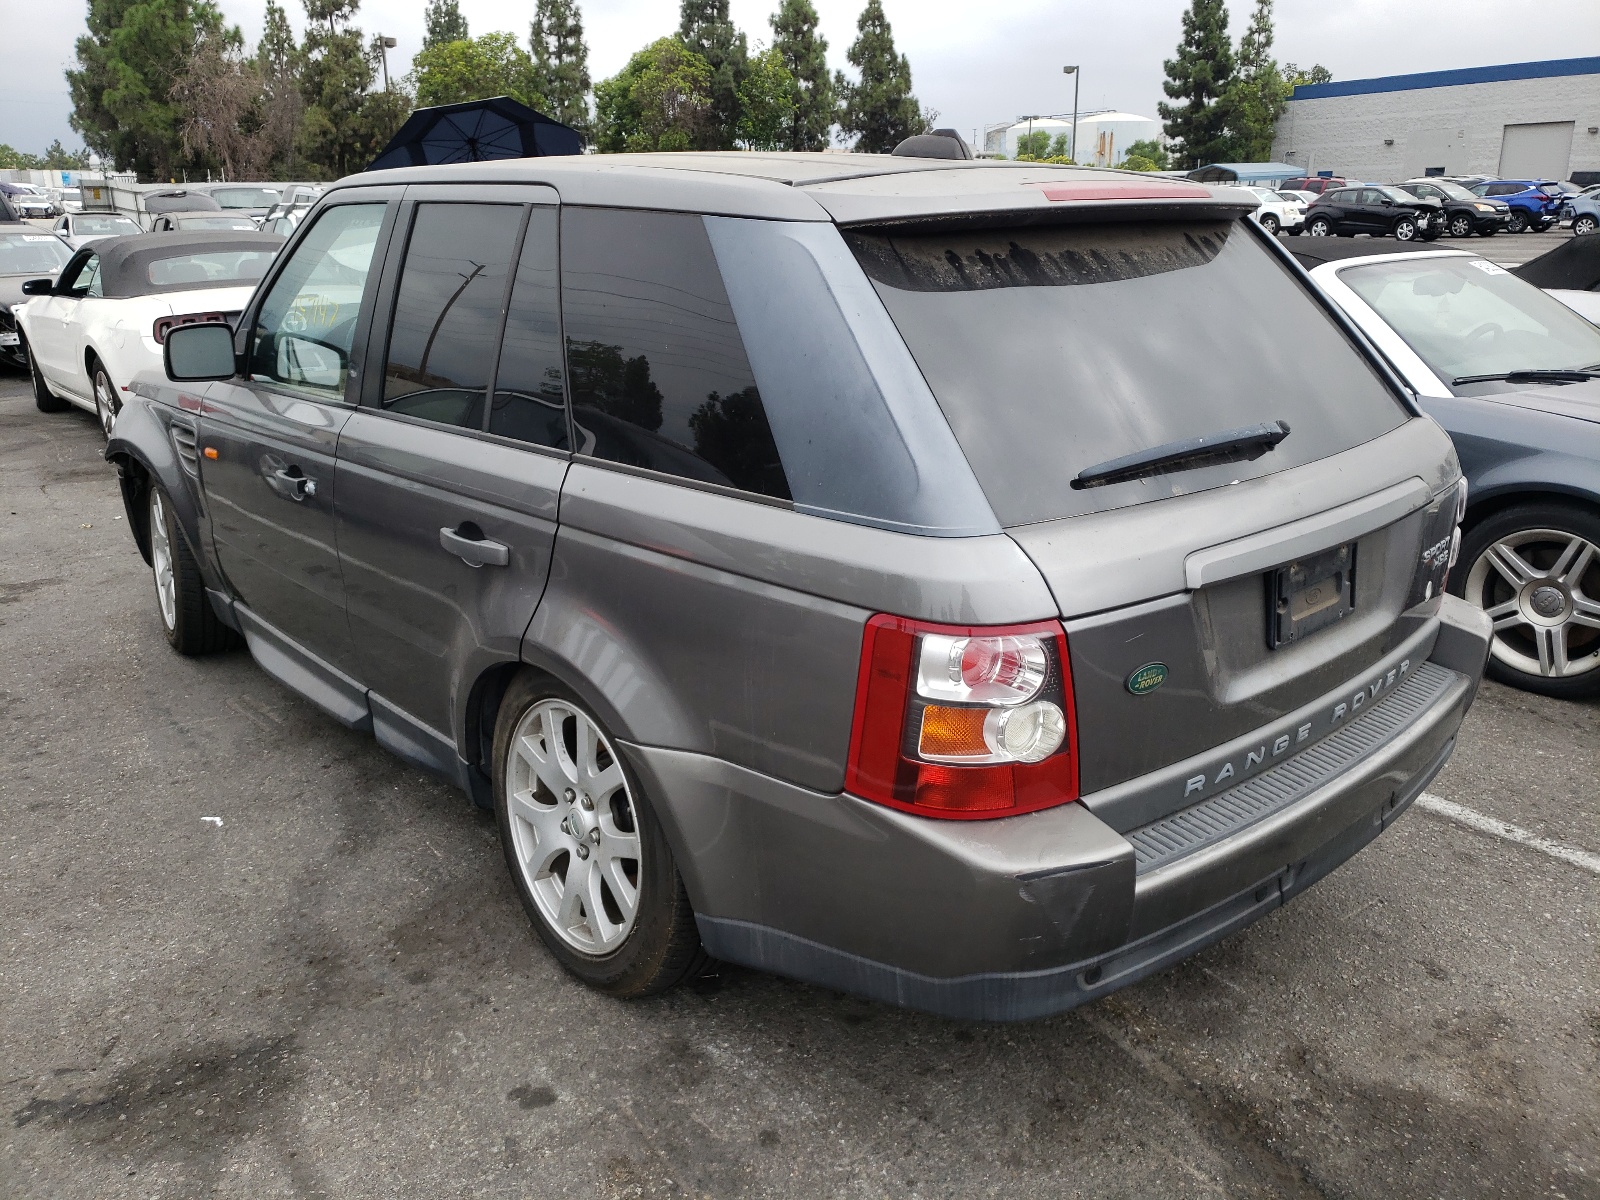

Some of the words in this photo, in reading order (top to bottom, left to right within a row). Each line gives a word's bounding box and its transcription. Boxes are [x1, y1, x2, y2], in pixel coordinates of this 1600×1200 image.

[1422, 535, 1451, 562] SPORT
[1138, 668, 1159, 682] LAND
[1138, 674, 1163, 690] ROVER
[1183, 722, 1312, 798] RANGE
[1331, 659, 1410, 724] ROVER
